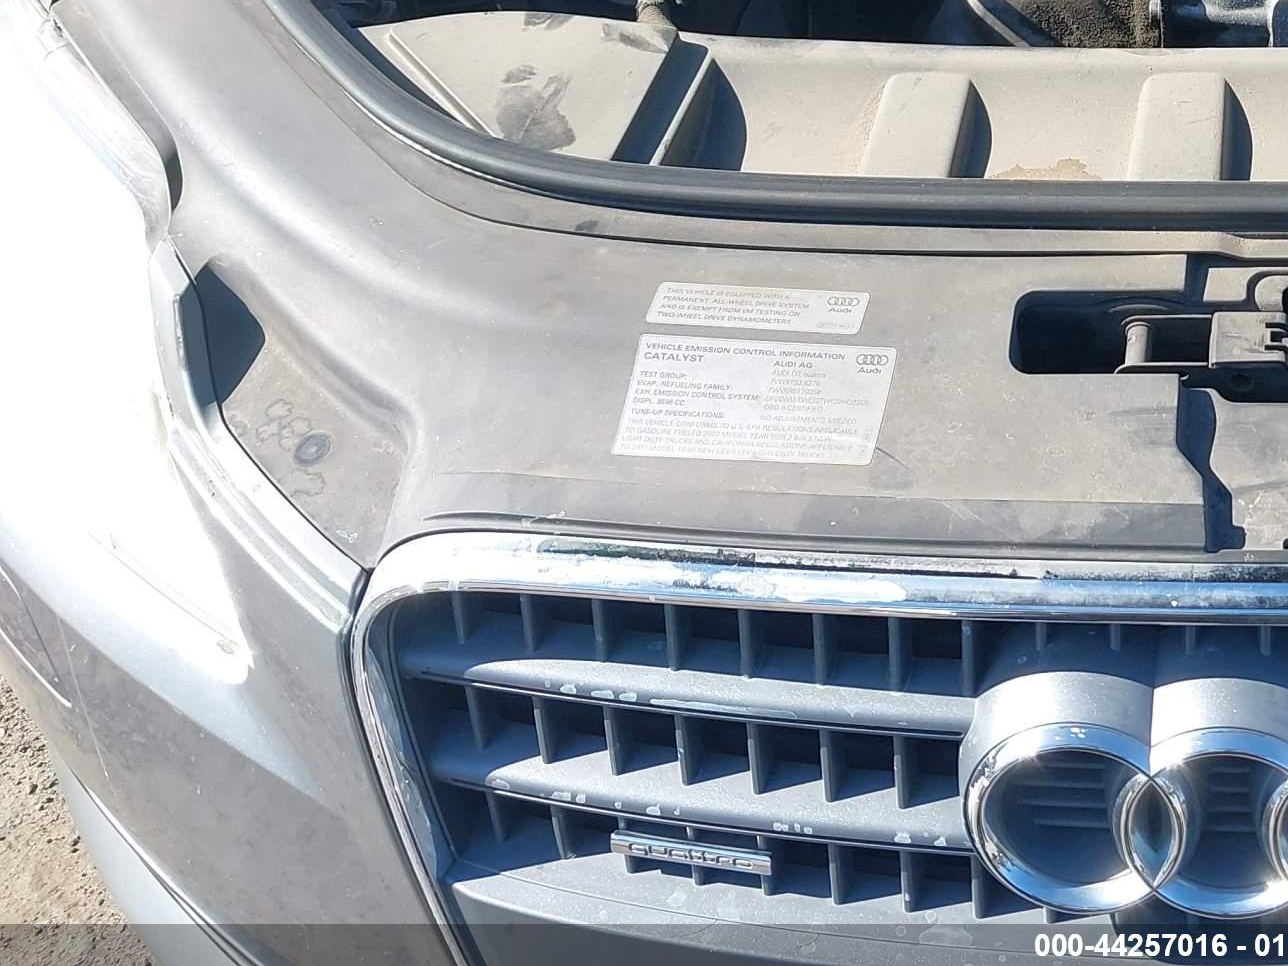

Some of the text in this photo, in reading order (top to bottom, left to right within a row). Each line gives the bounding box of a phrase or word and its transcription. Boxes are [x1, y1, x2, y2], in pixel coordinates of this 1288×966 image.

[685, 288, 715, 296] VEHICLE
[711, 298, 753, 306] ALL-WHEEL
[778, 301, 810, 309] SYSTEM
[687, 304, 717, 312] EXEMPT
[755, 308, 787, 316] TESTING
[657, 310, 701, 320] TWO-WHEEL
[727, 315, 792, 325] DYNAMOMETERS
[643, 351, 704, 363] CATALYST
[645, 342, 846, 361] VEHICLE EMISSION CONTROL INFORMATION
[773, 360, 813, 369] AUDI AG
[640, 370, 687, 380] TEST GROUP:
[856, 366, 882, 375] Audi
[653, 389, 690, 398] EMISSION
[690, 391, 726, 400] CONTROL
[727, 393, 761, 401] SYSTEM:
[631, 407, 726, 419] TUNE-UP SPECIFICATIONS:
[762, 424, 813, 434] REGULATIONS
